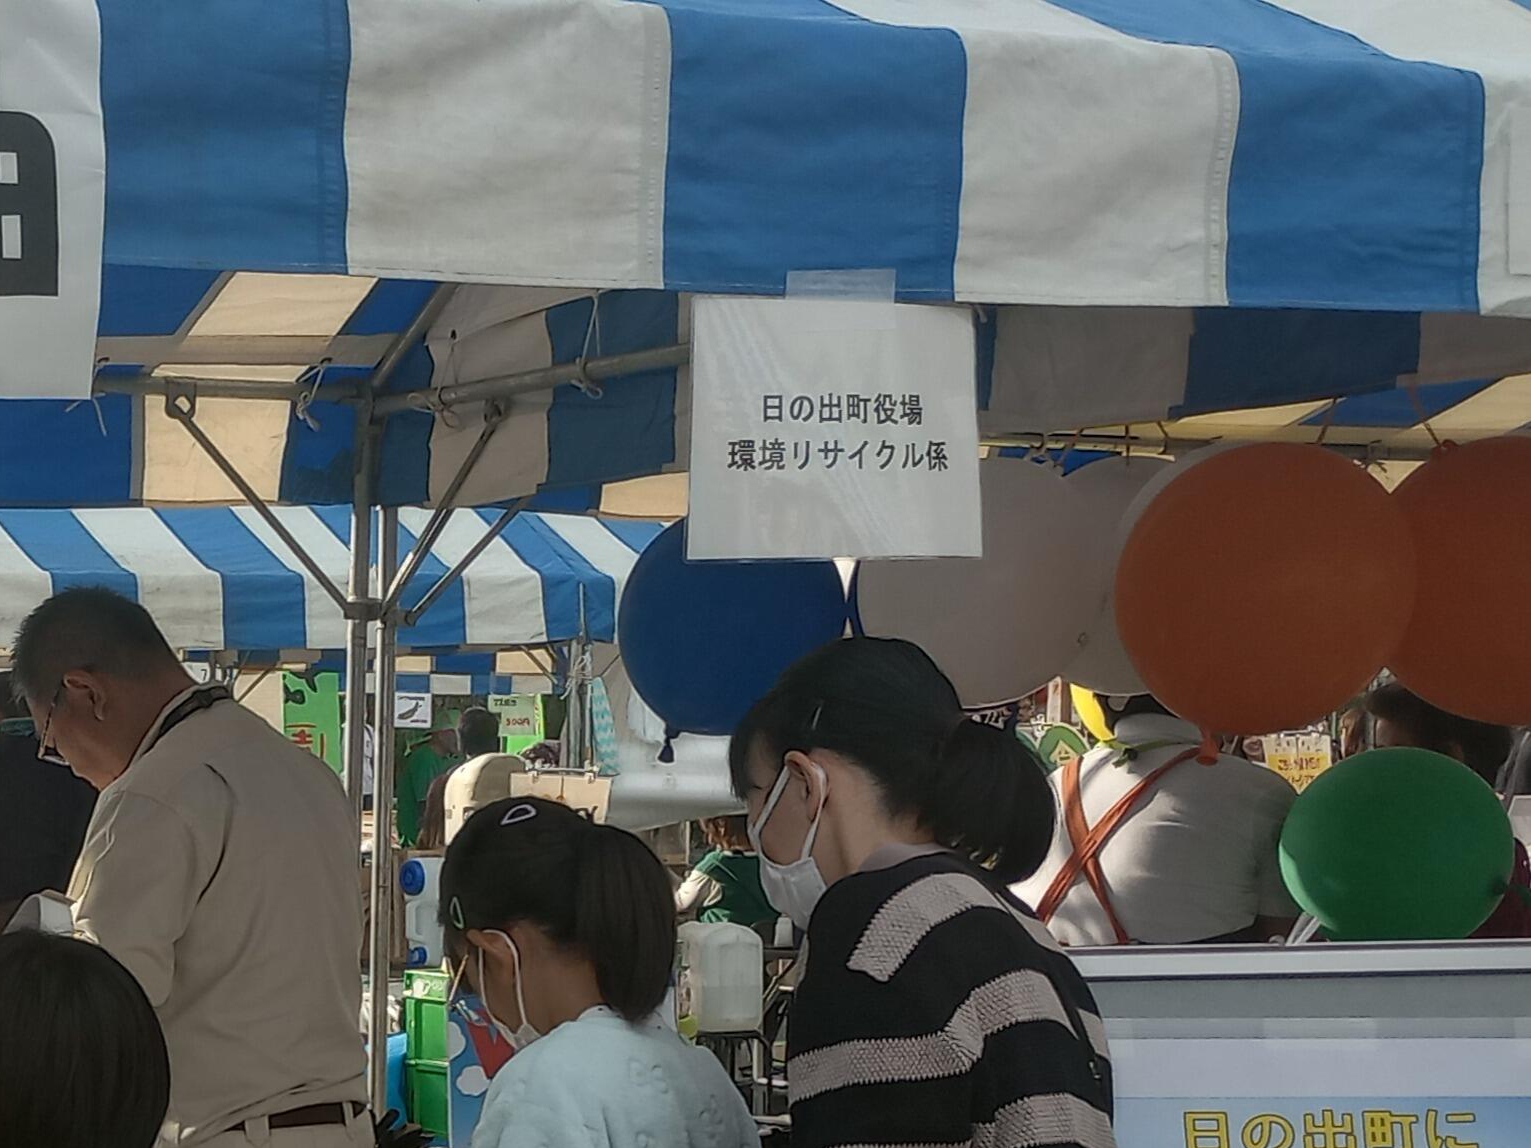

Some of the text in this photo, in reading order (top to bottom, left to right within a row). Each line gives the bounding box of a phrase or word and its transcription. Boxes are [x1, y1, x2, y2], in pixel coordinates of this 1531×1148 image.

[762, 393, 923, 425] 日の出町役場
[727, 439, 948, 471] 環境リサイクル係
